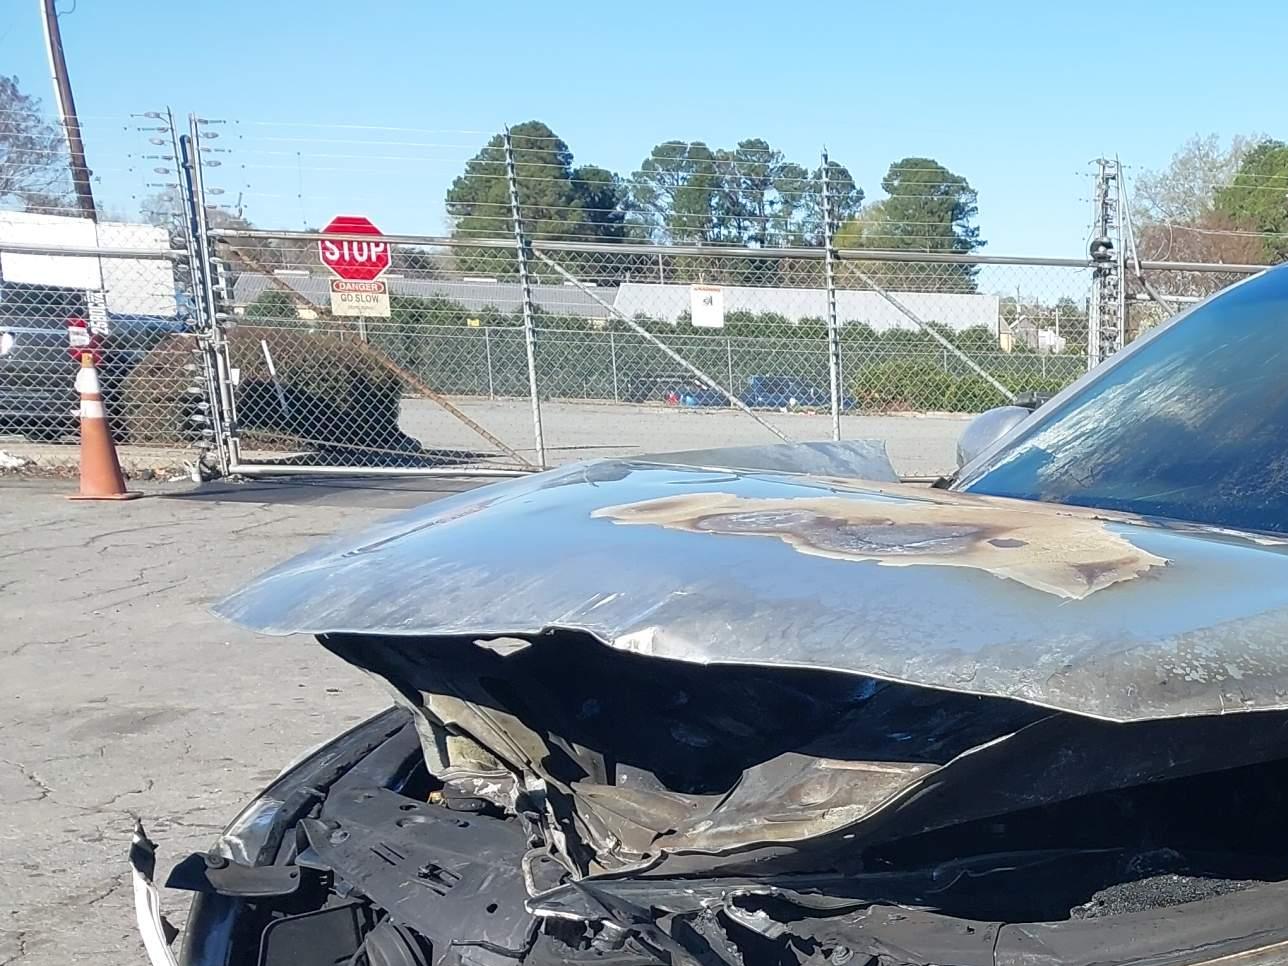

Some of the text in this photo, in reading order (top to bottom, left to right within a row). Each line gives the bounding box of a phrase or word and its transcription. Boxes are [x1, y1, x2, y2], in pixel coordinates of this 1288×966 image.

[324, 239, 385, 262] STOP
[339, 283, 378, 291] DANGER
[340, 293, 379, 304] GO SLOW
